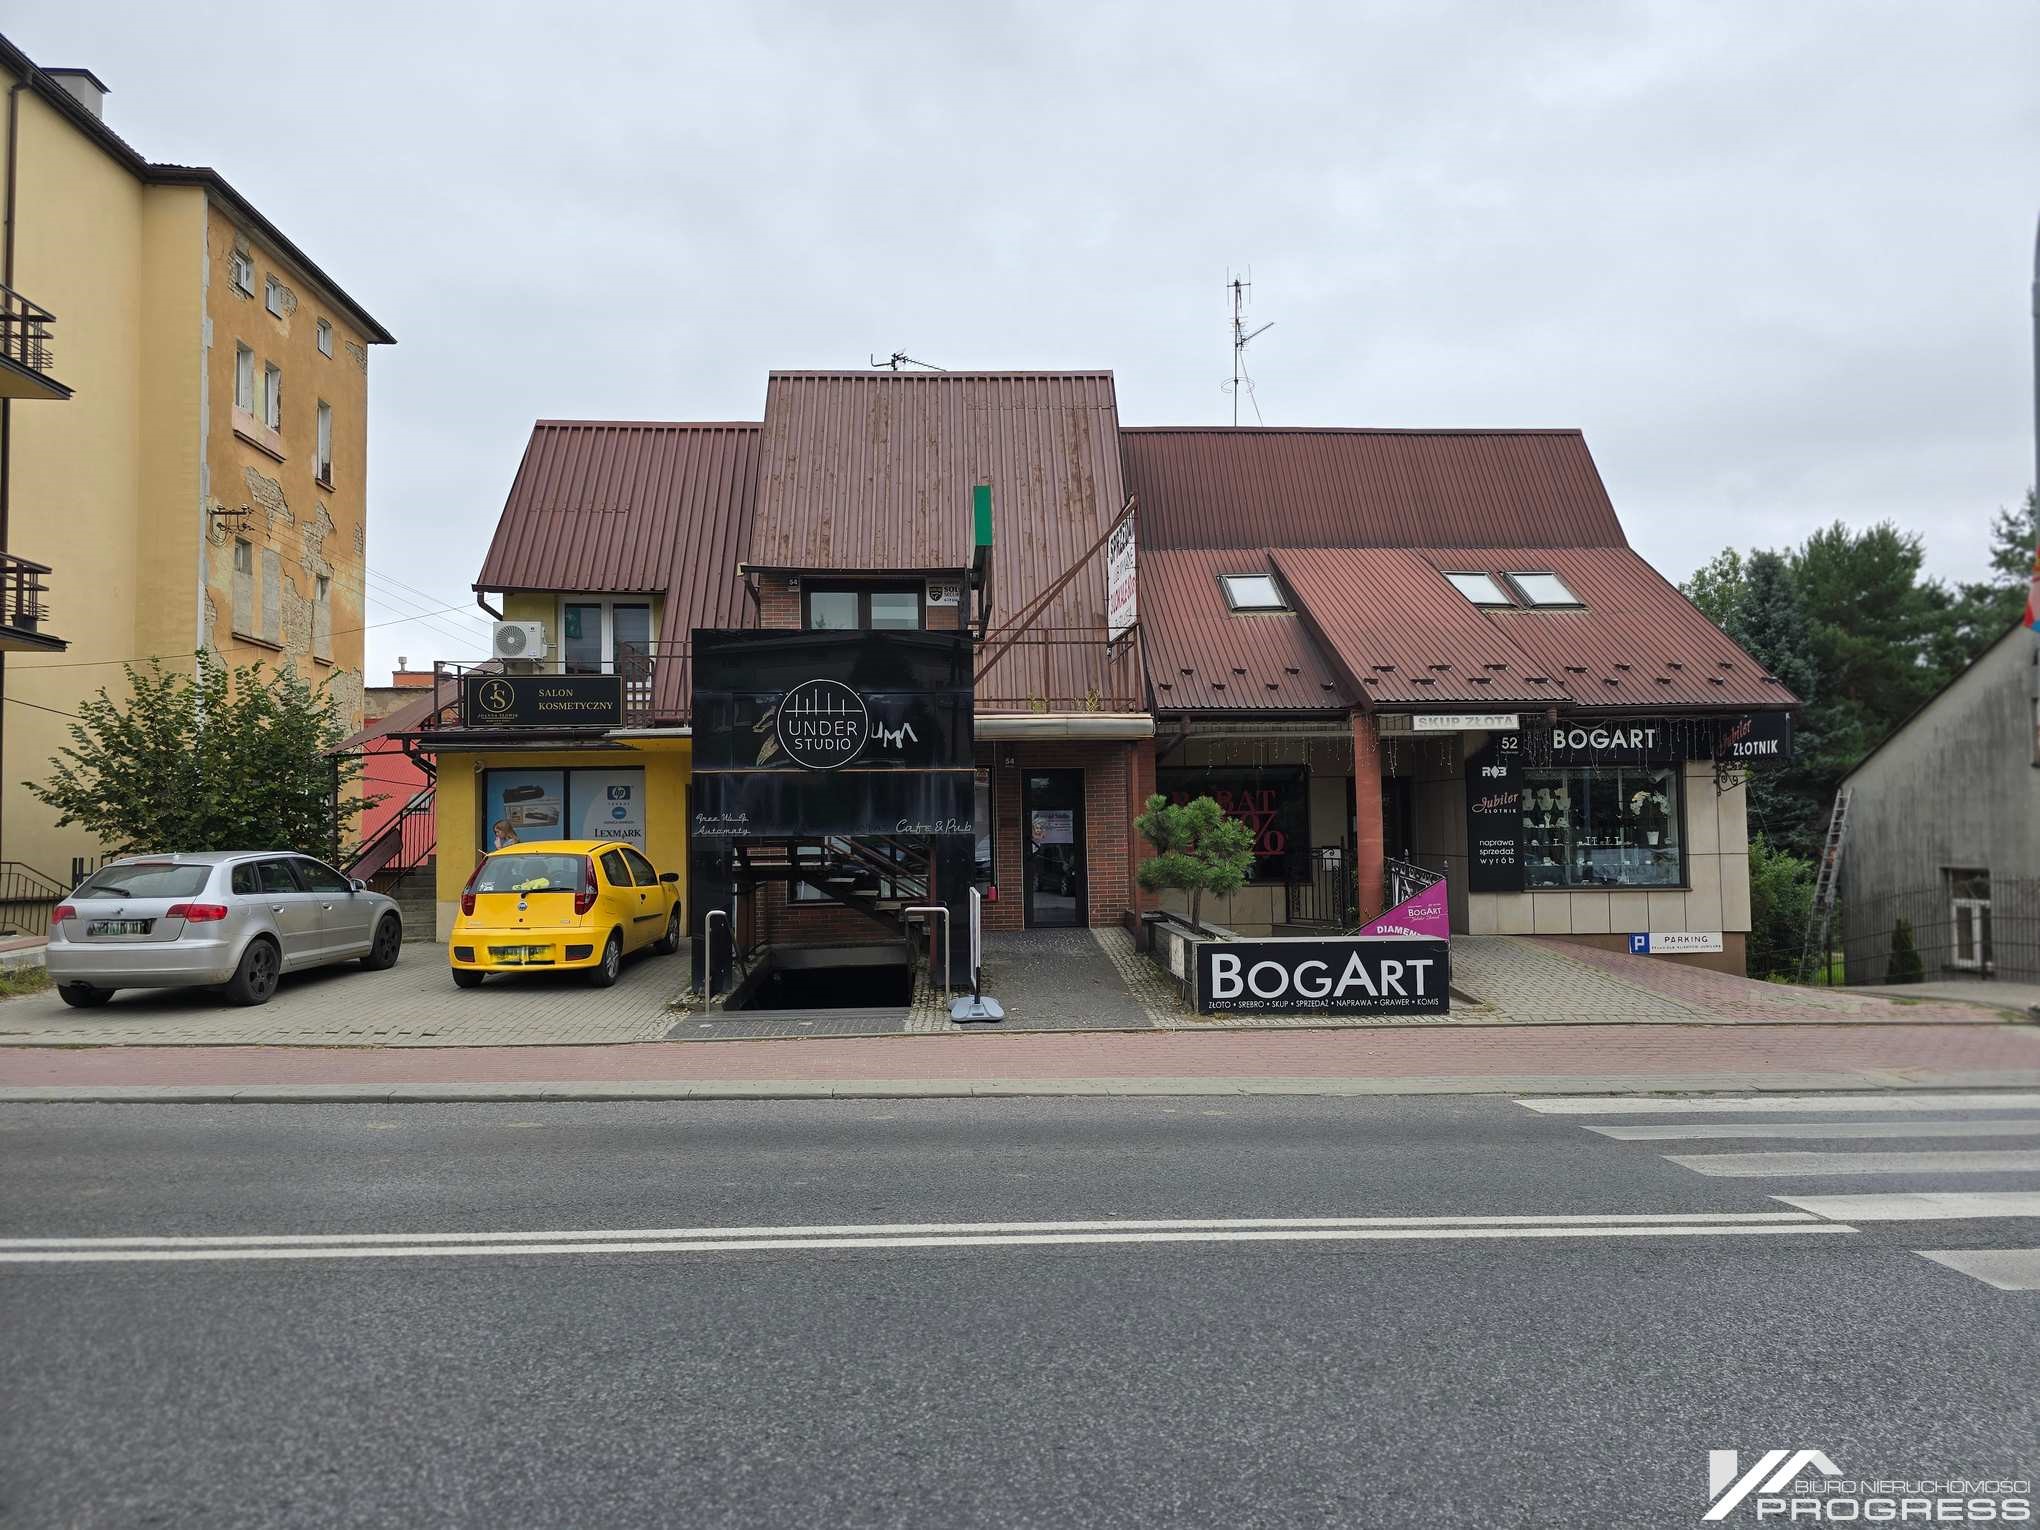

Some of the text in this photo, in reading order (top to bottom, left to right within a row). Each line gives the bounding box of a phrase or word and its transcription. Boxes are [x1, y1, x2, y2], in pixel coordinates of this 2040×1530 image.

[538, 689, 573, 697] SALON
[538, 702, 614, 710] KOSMETYCZNY
[788, 720, 858, 736] UNDER
[1418, 715, 1514, 728] SKUP ZŁOTA
[794, 738, 851, 751] STUDIO
[1501, 737, 1518, 749] 52
[1552, 728, 1656, 749] BOGART
[1733, 739, 1778, 756] ZŁOTNIK
[1004, 757, 1015, 765] 54
[1171, 789, 1277, 813] RBAT
[1471, 791, 1519, 813] Jubiler
[944, 818, 972, 834] Pub
[594, 828, 642, 839] LEXMARK
[1479, 839, 1514, 847] naprawa
[1479, 847, 1515, 856] sprzedaż
[1634, 935, 1645, 950] P
[1208, 1001, 1231, 1009] ZŁOTO
[1271, 1000, 1289, 1008] SKUP
[1295, 998, 1329, 1008] SPRZEDAŻ
[1336, 999, 1372, 1007] NAPRAWA
[1380, 998, 1410, 1007] GRAWER
[1416, 997, 1439, 1006] KOMIS
